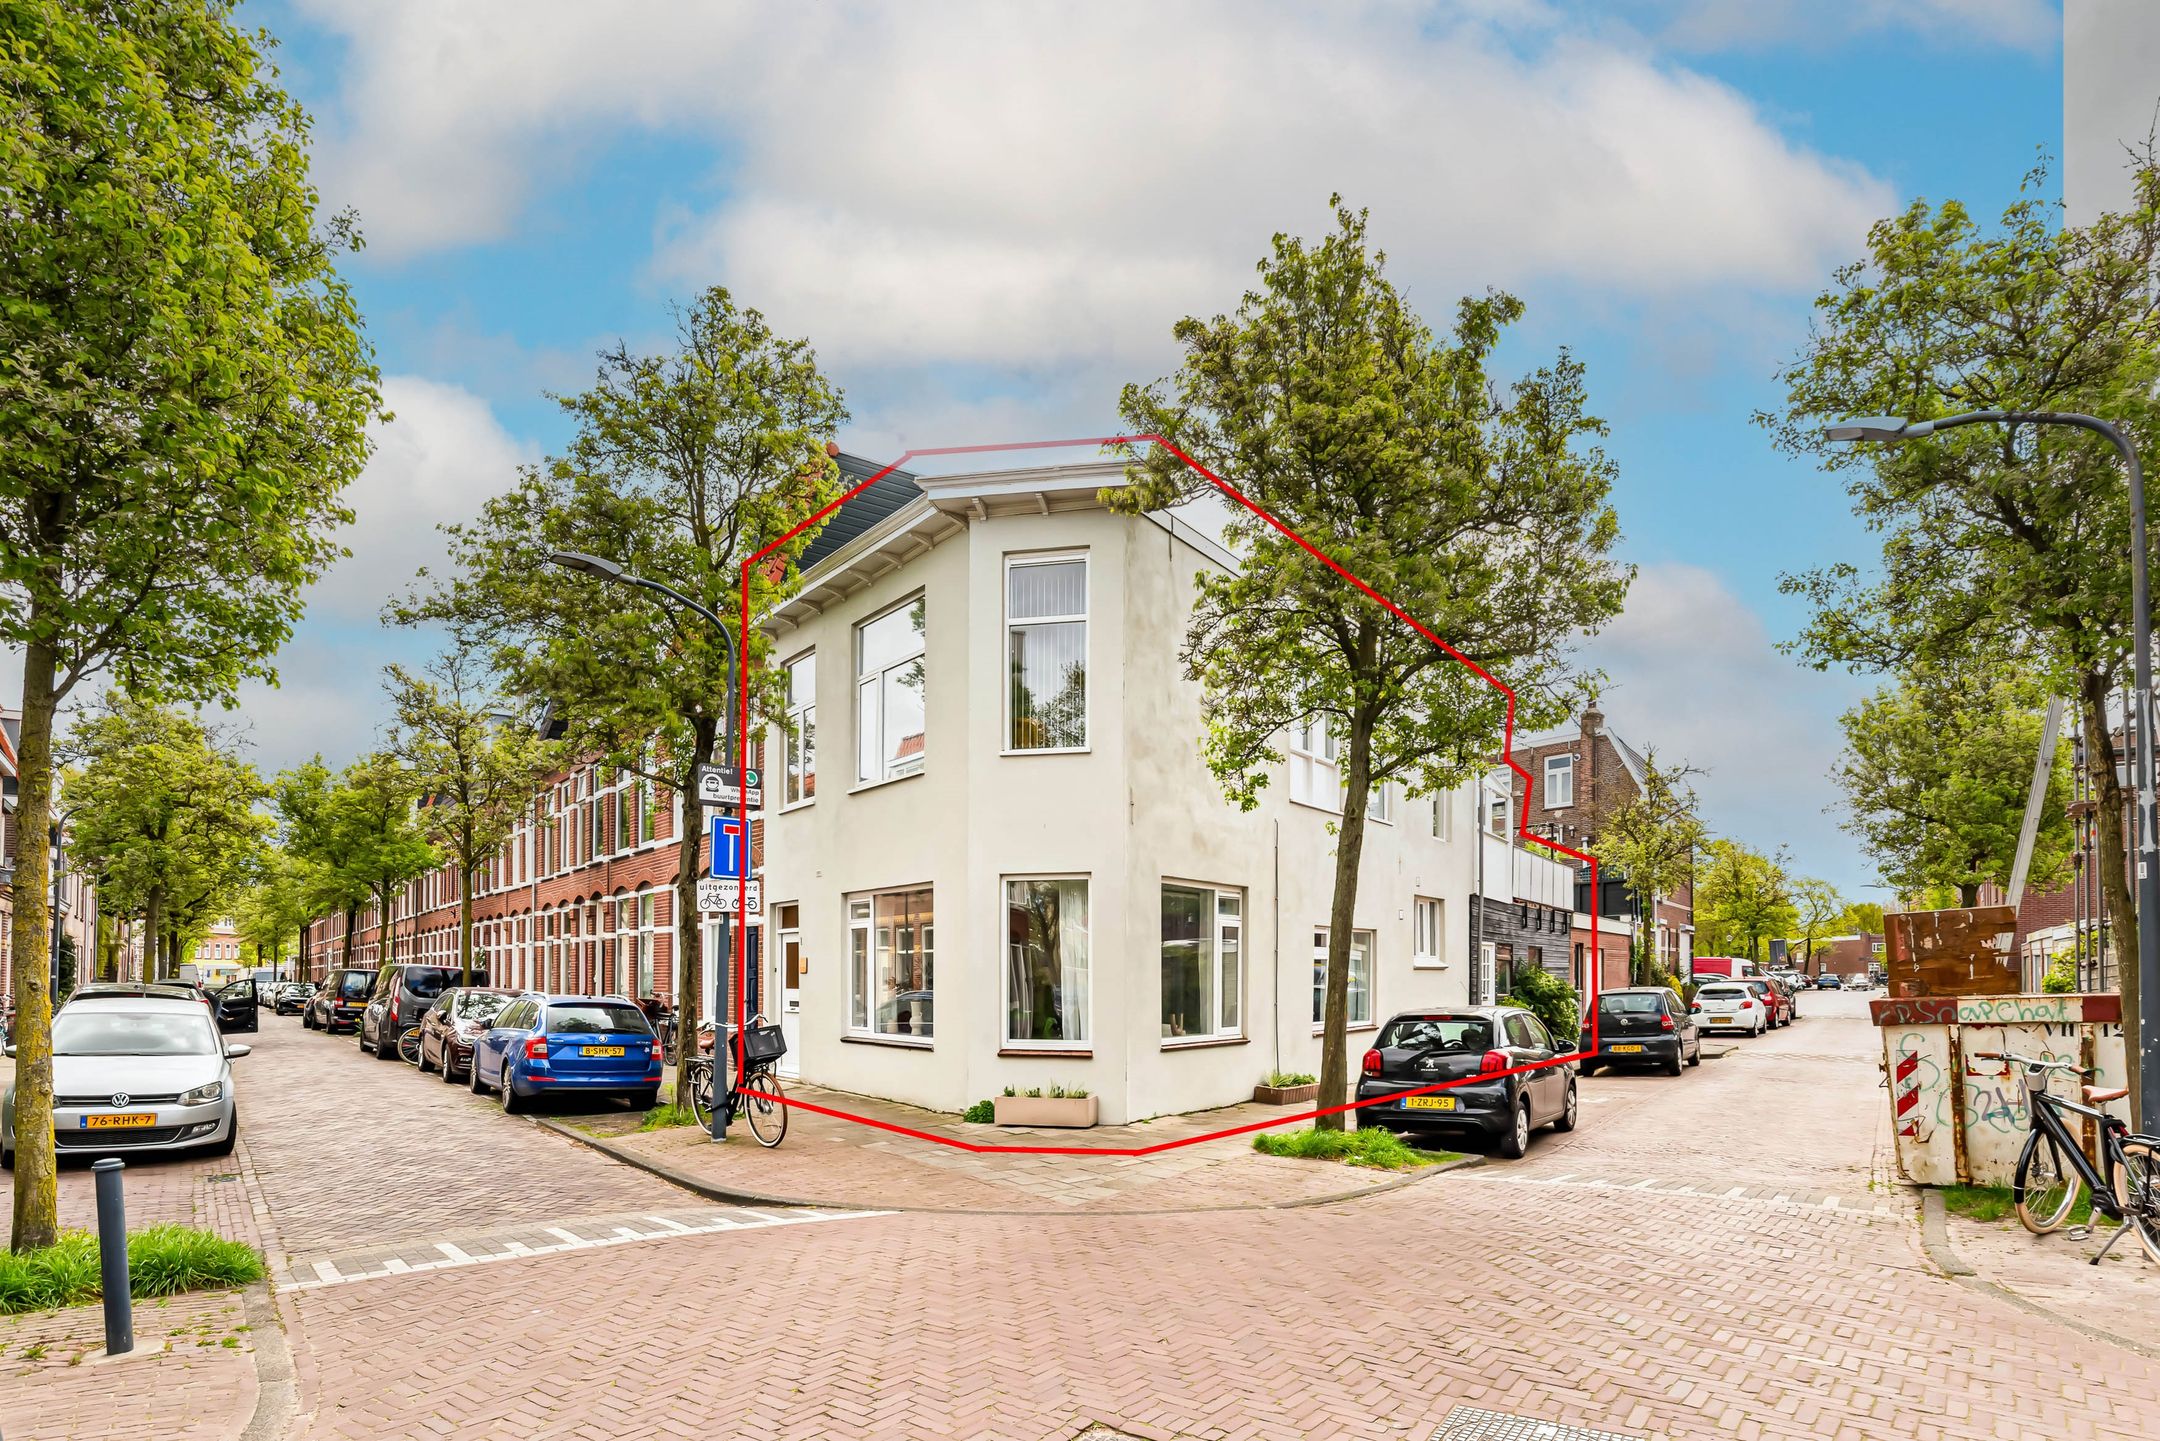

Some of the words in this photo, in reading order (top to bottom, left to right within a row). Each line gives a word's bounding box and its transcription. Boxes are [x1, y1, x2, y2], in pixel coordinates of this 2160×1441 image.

[701, 765, 733, 775] Attentie!
[699, 883, 758, 893] uitgezonerd
[1411, 1098, 1449, 1108] 1-ZRJ-95
[91, 1115, 152, 1127] 76-RHK-7
